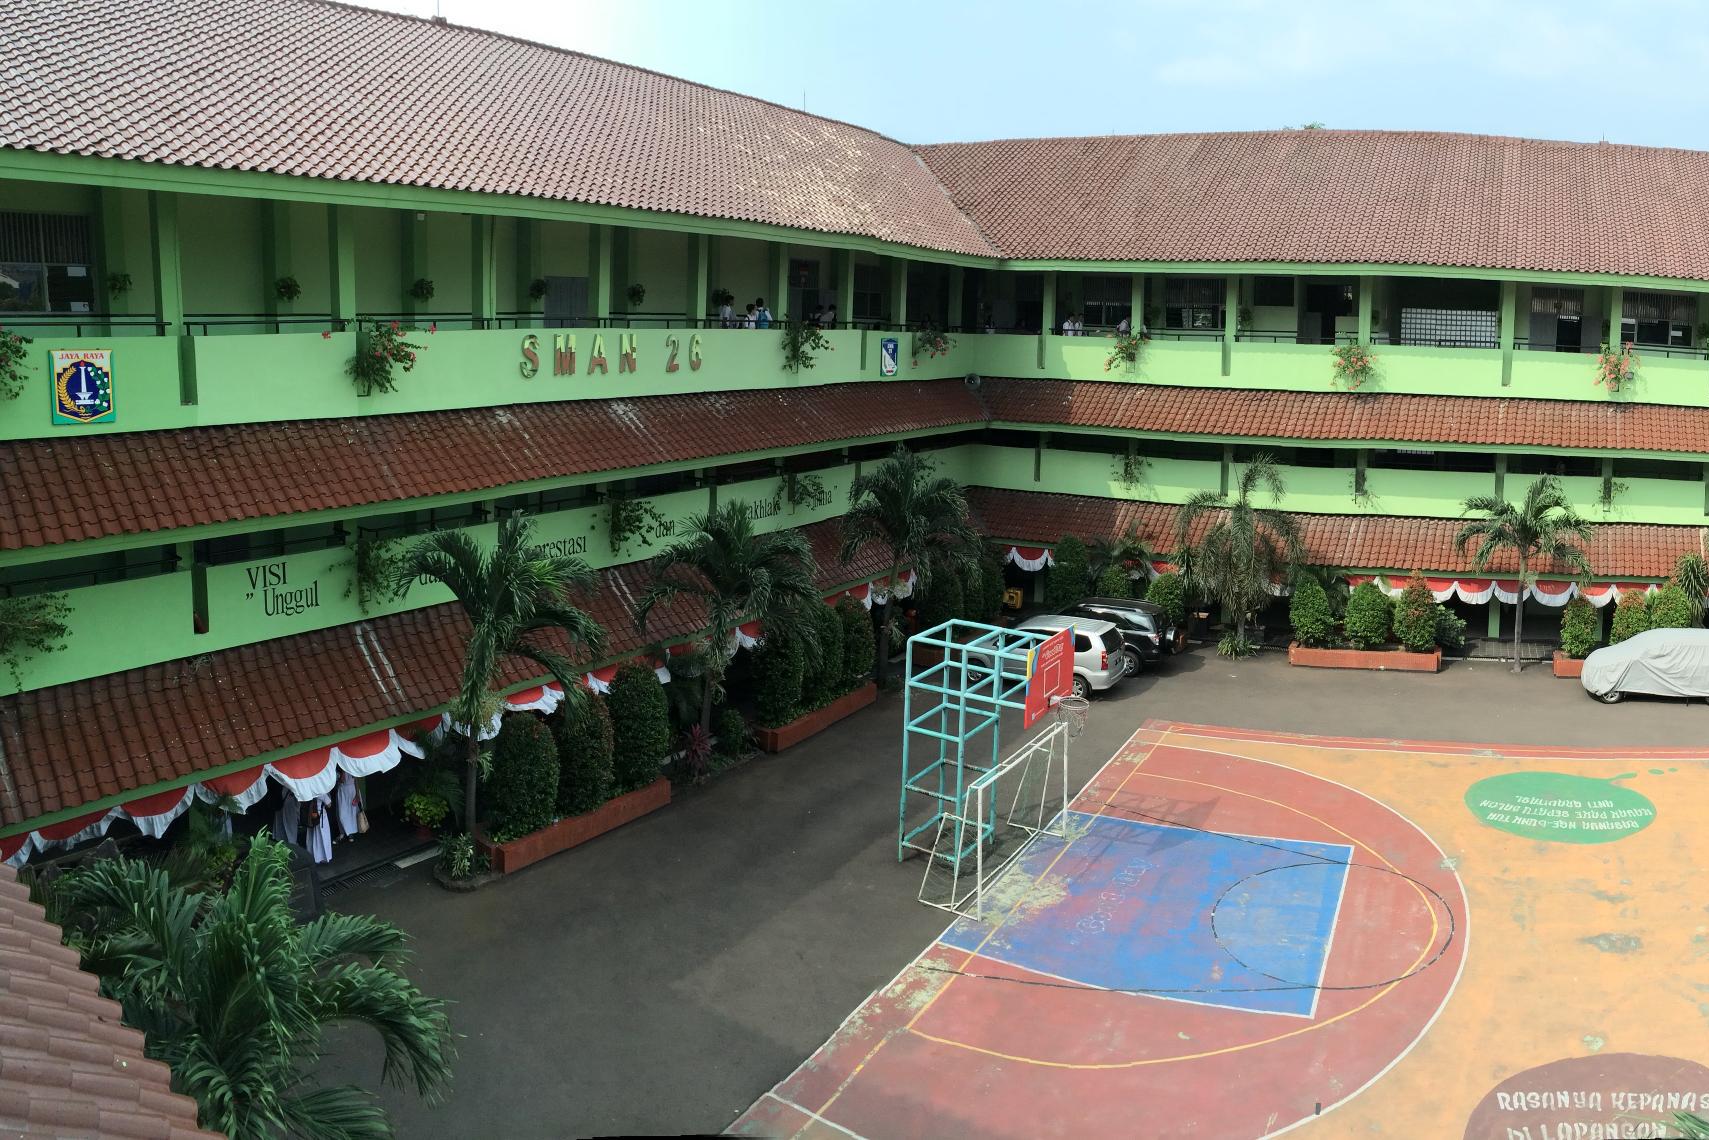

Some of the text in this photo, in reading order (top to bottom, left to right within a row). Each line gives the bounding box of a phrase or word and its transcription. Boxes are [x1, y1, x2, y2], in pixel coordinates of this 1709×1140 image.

[59, 352, 105, 360] JAYA RAYA
[520, 333, 702, 378] SMAN 26
[246, 561, 288, 590] VISI
[263, 579, 320, 616] Unggul
[1575, 809, 1608, 819] PAKE
[1587, 799, 1614, 809] ANTI
[1496, 1090, 1603, 1112] RASANYA
